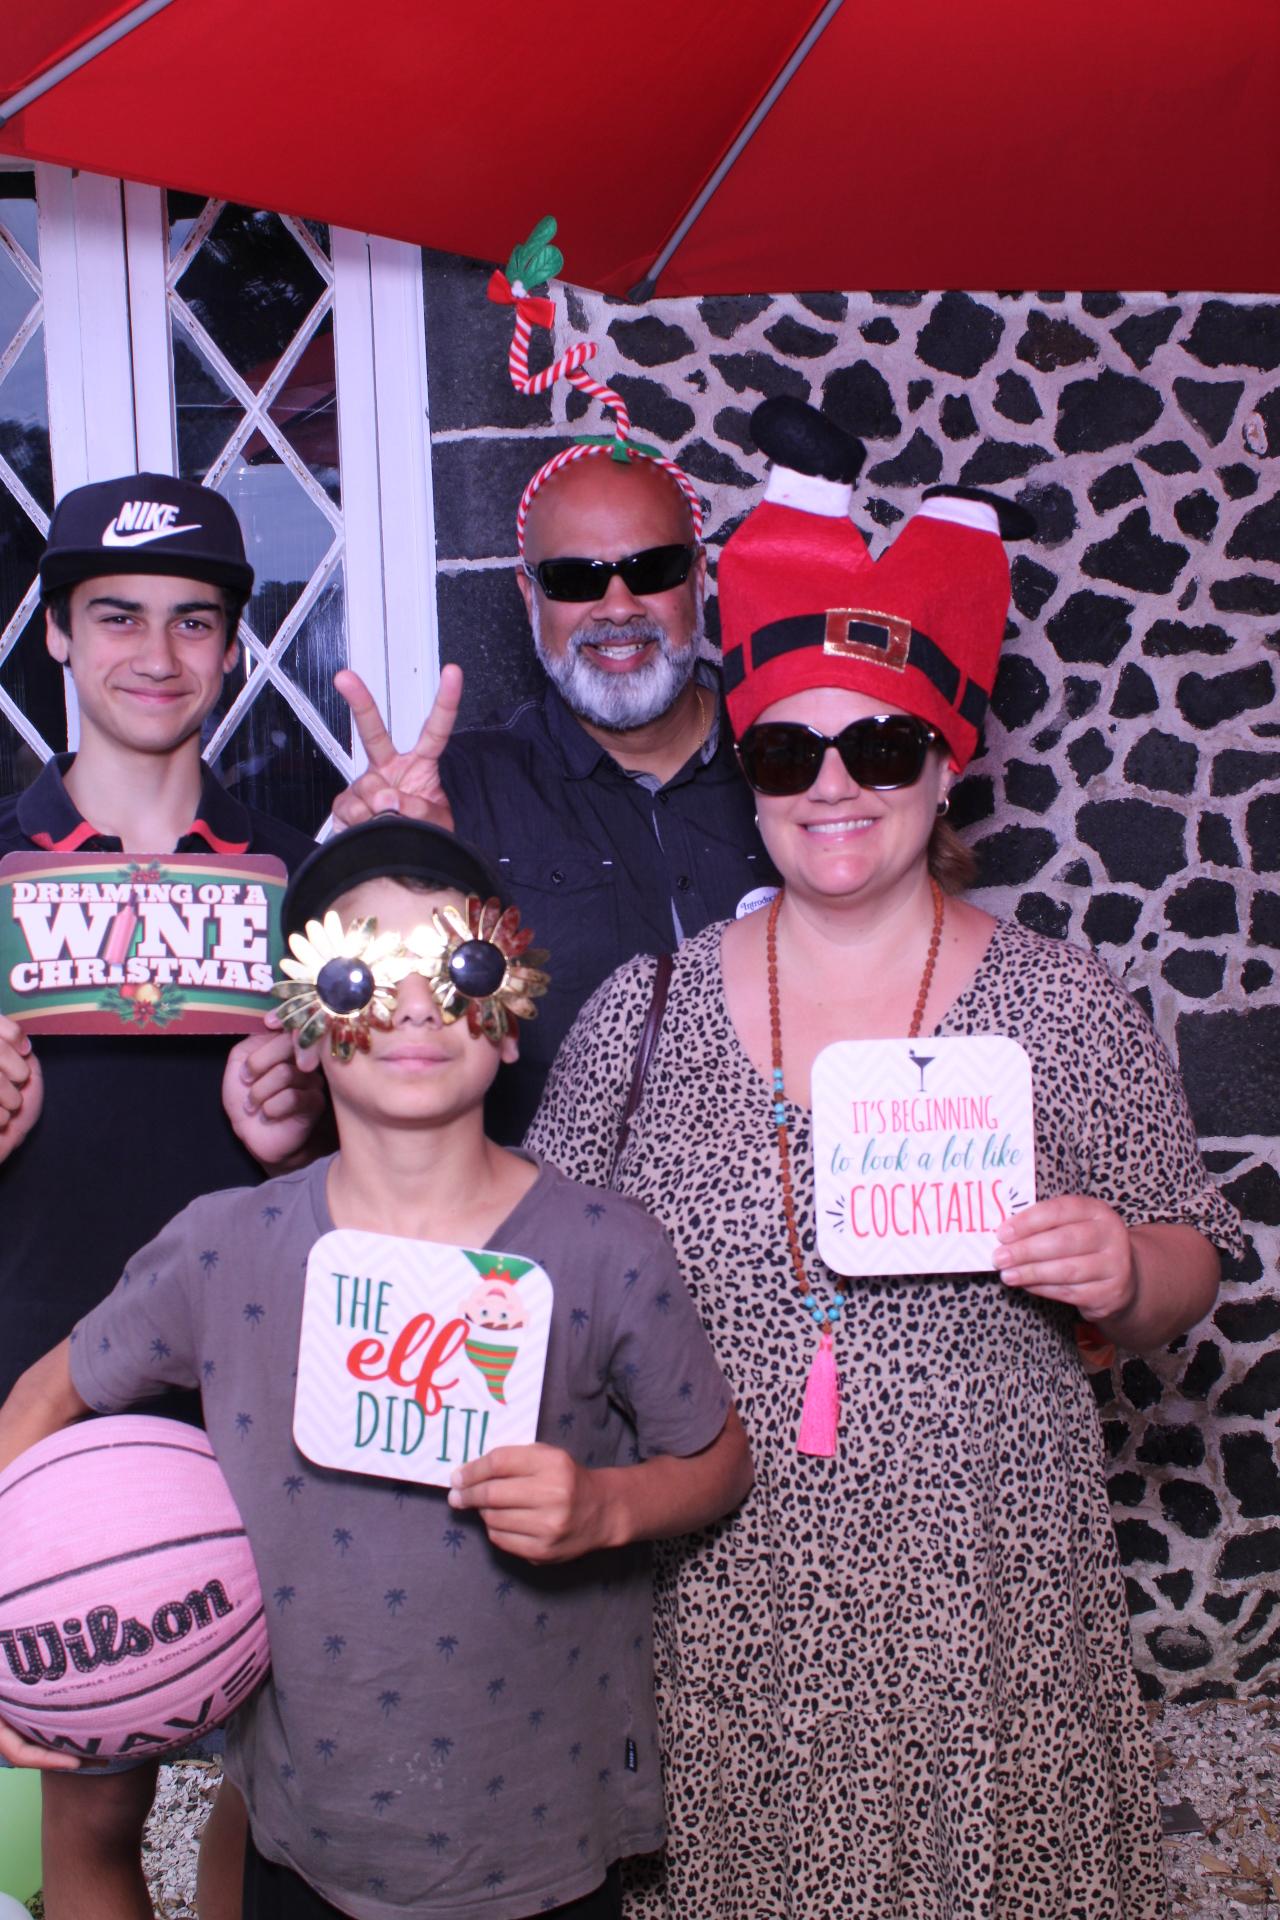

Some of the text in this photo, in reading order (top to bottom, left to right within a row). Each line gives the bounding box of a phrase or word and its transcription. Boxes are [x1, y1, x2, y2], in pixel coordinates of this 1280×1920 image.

[117, 501, 179, 531] NIKE
[13, 883, 267, 904] DREAMING OF A
[13, 903, 267, 963] WINE
[10, 958, 274, 992] CHRISTMAS
[852, 1095, 998, 1134] IT'S BEGINNING
[830, 1133, 1023, 1176] to look a lot like
[851, 1179, 1007, 1238] COCKTAILS
[331, 1272, 393, 1335] THE
[346, 1312, 471, 1417] elf
[354, 1391, 490, 1464] DID IT!
[0, 1578, 234, 1686] Wilson
[27, 1651, 263, 1757] WAVE
